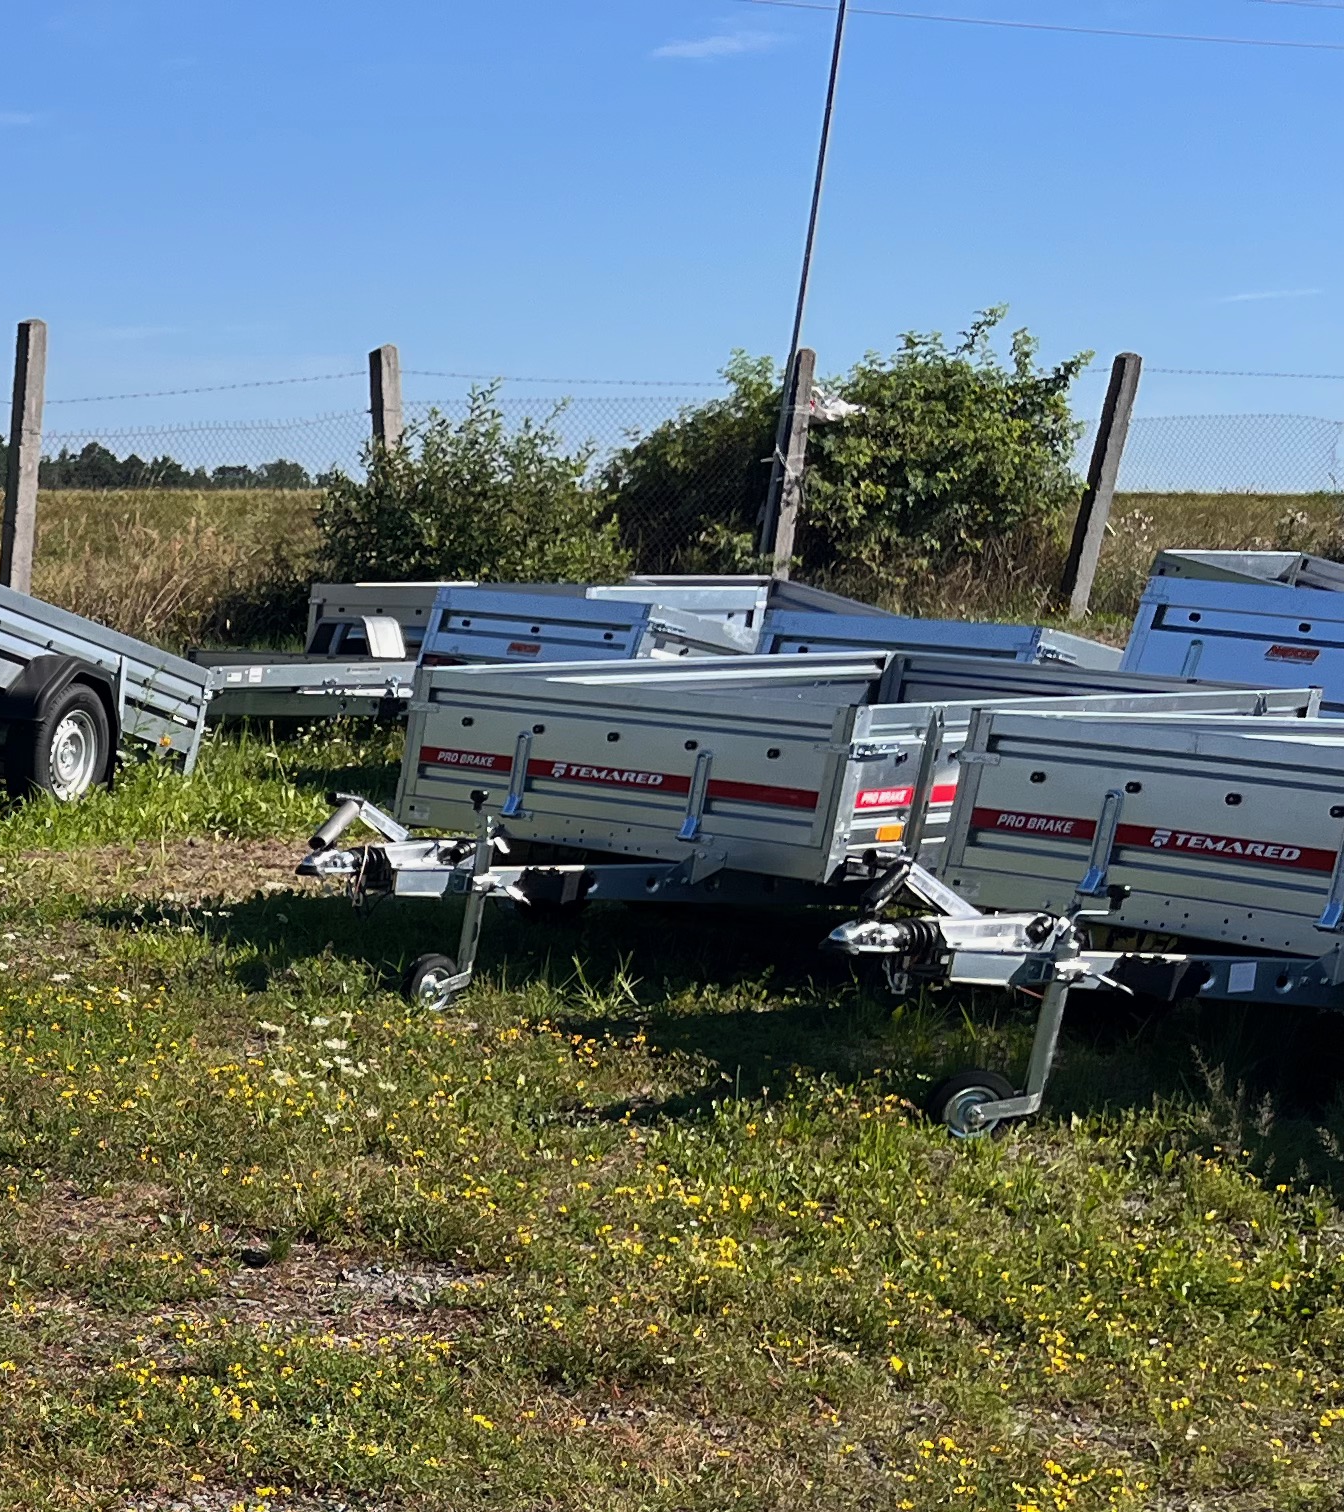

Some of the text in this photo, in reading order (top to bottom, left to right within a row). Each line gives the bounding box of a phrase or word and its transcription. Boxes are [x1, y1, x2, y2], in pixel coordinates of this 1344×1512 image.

[437, 751, 495, 767] PRO BRAKE
[570, 766, 663, 785] TEMARED
[860, 790, 907, 804] PRO BRAKE
[997, 814, 1075, 833] PRO BRAKE
[1175, 833, 1302, 861] TEMARED
